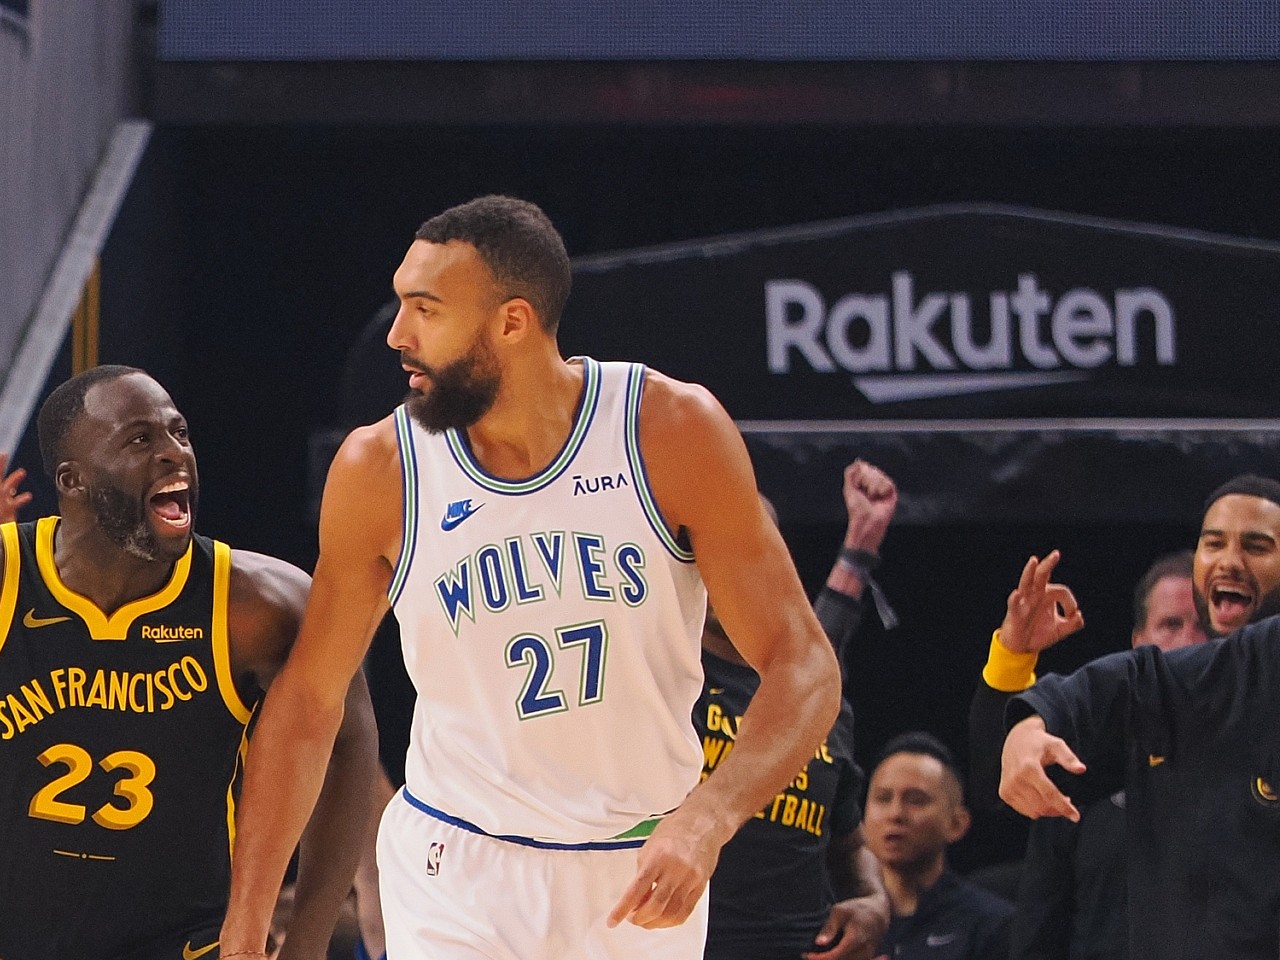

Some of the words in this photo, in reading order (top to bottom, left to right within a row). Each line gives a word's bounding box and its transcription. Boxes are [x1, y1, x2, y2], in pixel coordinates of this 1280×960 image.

[764, 270, 1177, 374] Rakuten
[446, 499, 472, 520] NIKE
[433, 531, 649, 638] WOLVES
[142, 625, 203, 639] Rakuten
[504, 619, 608, 721] 27
[50, 656, 208, 713] FRANCISCO
[28, 743, 156, 831] 23
